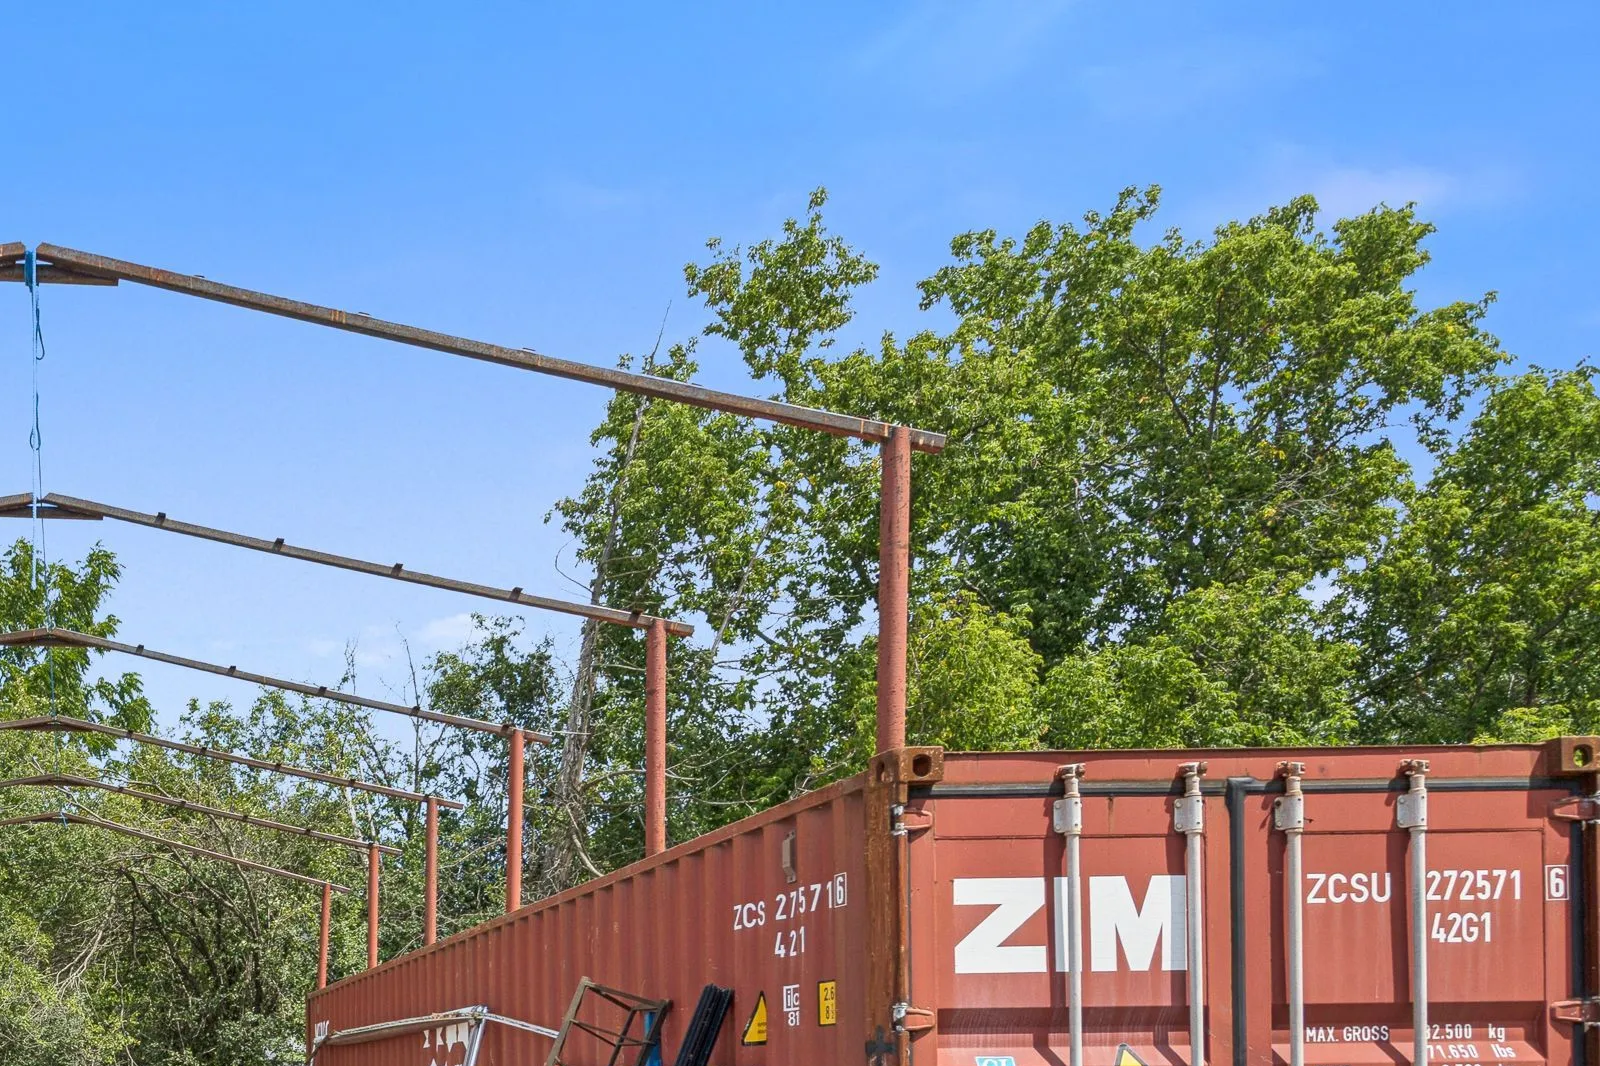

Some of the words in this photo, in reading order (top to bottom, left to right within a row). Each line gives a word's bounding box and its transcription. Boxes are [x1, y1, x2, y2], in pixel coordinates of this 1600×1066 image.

[1306, 873, 1392, 904] ZCSU
[1426, 869, 1521, 901] 272571
[1548, 866, 1566, 898] 6
[953, 874, 1189, 974] ZIM
[1431, 911, 1491, 943] 42G1
[1305, 1026, 1339, 1043] MAX.
[1343, 1025, 1390, 1041] GROSS
[1488, 1023, 1506, 1042] kg
[1490, 1044, 1517, 1059] lbs
